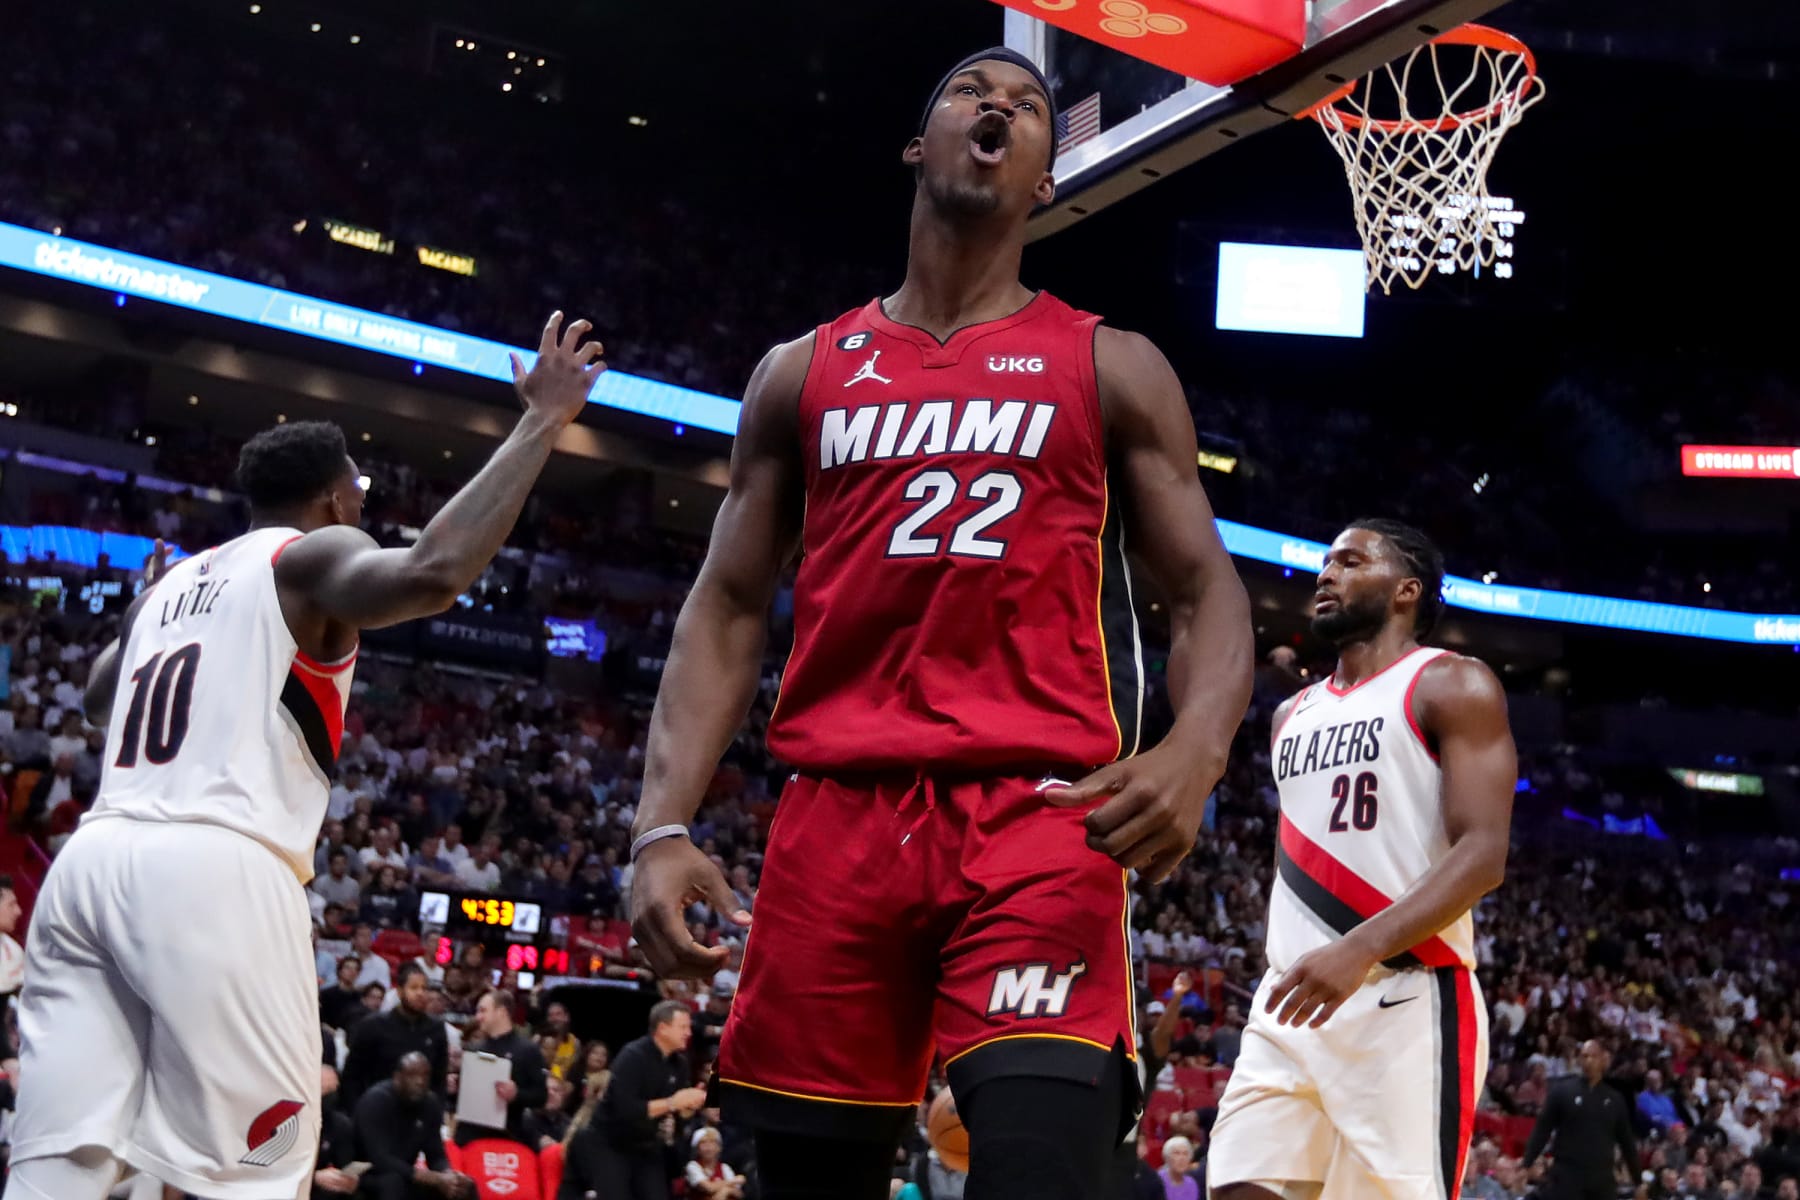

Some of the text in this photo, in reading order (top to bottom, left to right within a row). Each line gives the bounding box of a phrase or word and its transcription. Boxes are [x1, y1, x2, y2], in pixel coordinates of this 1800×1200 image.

[34, 242, 210, 303] ticketmaster
[843, 333, 866, 350] 6
[820, 400, 1056, 470] MIAMI
[1695, 452, 1792, 471] STREAM LIVE
[884, 468, 1024, 559] 22
[160, 578, 230, 629] LITTLE
[114, 642, 202, 769] 10
[1278, 717, 1385, 782] BLAZERS
[1328, 770, 1379, 833] 26
[461, 898, 514, 926] 4:53
